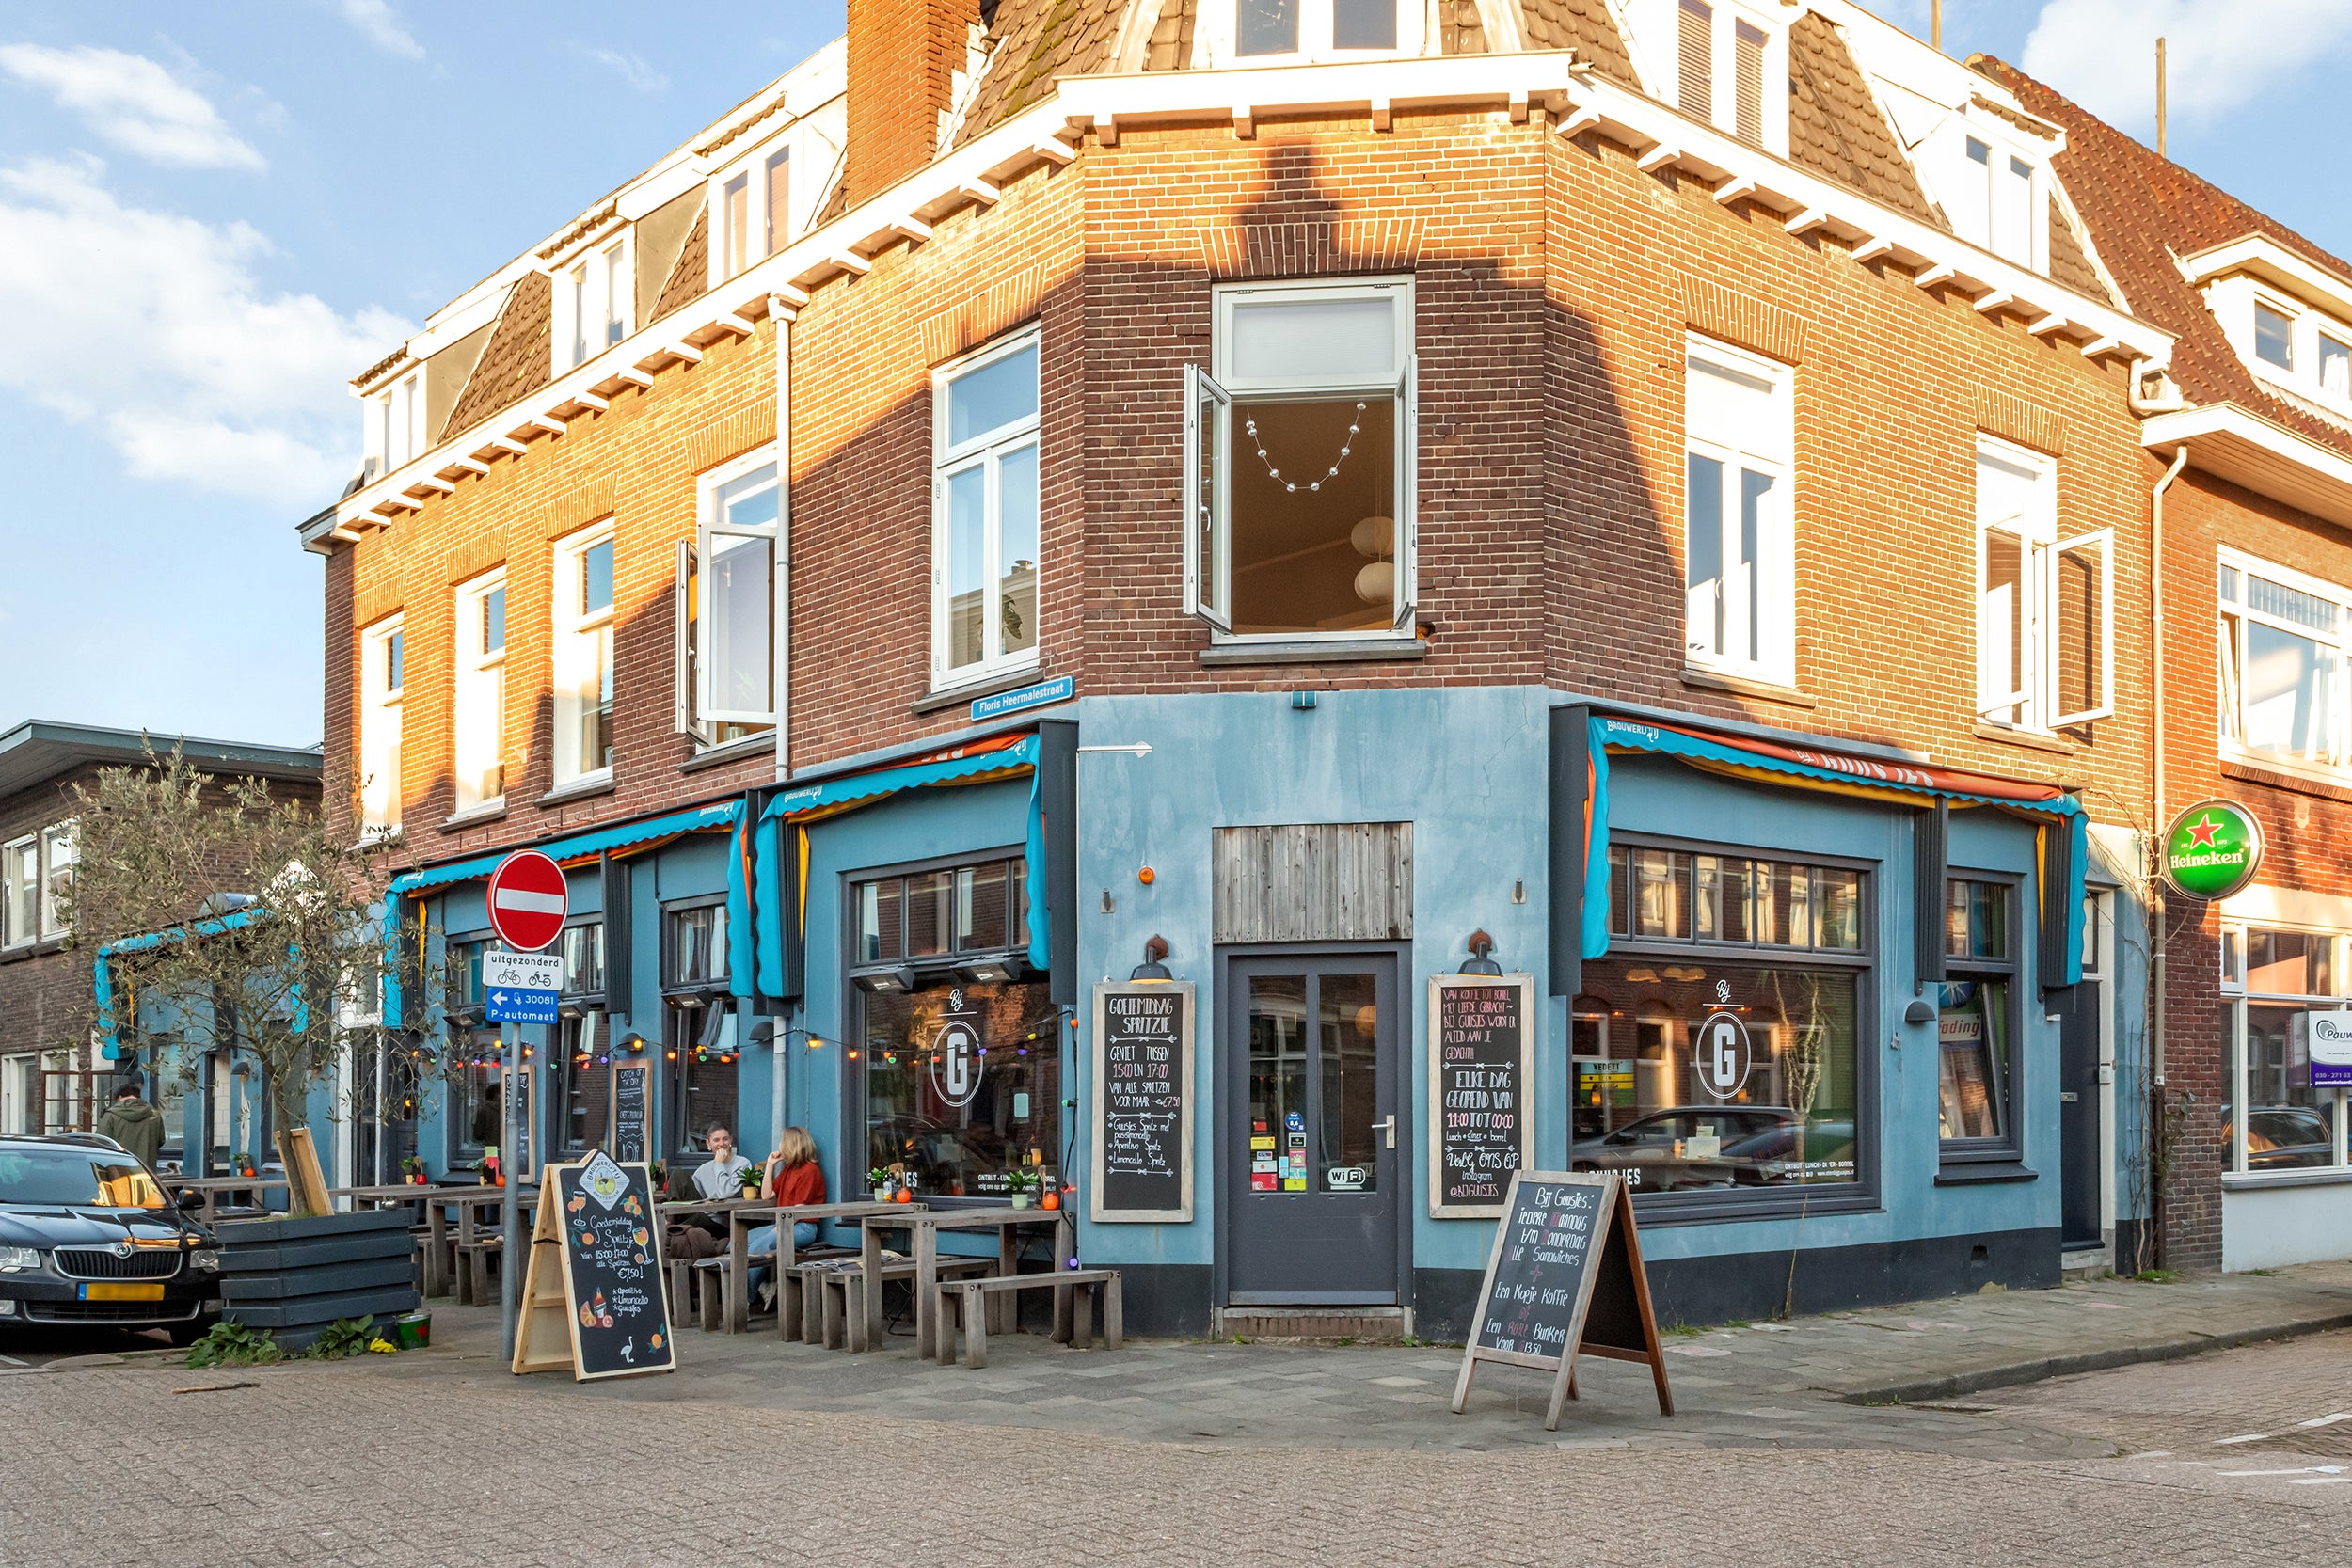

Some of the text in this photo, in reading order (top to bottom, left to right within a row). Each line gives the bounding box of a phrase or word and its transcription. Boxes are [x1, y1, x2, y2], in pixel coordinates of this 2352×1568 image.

[979, 682, 1064, 713] Floris Heermalestraat
[2170, 851, 2244, 869] Heineken
[491, 955, 559, 968] uitgezonderd
[1443, 990, 1457, 1000] VAN
[1715, 979, 1732, 1004] Bij
[525, 995, 554, 1005] 30081
[949, 988, 963, 1012] Bij
[1443, 1002, 1455, 1014] MET
[1457, 1001, 1476, 1014] LIEFDE
[491, 1009, 554, 1021] P-automaat
[1109, 1045, 1170, 1061] GENIET TUSSEN
[1713, 1022, 1736, 1087] G
[946, 1032, 968, 1096] G
[1134, 1063, 1144, 1077] EN
[1146, 1063, 1168, 1078] 17:00
[1455, 1070, 1512, 1088] ELKE DAG
[1108, 1082, 1170, 1094] VAN ALLE SPRITZEN
[1113, 1095, 1131, 1107] VOOR
[1132, 1096, 1150, 1107] MAAR
[1445, 1090, 1514, 1109] GEOPEND VAN
[1447, 1112, 1514, 1129] 11:00 TOT 00:00
[1489, 1130, 1507, 1142] borrel
[1113, 1151, 1142, 1164] Limoncello
[1534, 1187, 1552, 1208] Bij
[1495, 1281, 1510, 1299] Een
[1513, 1283, 1538, 1304] Kopje
[1486, 1318, 1502, 1334] Een
